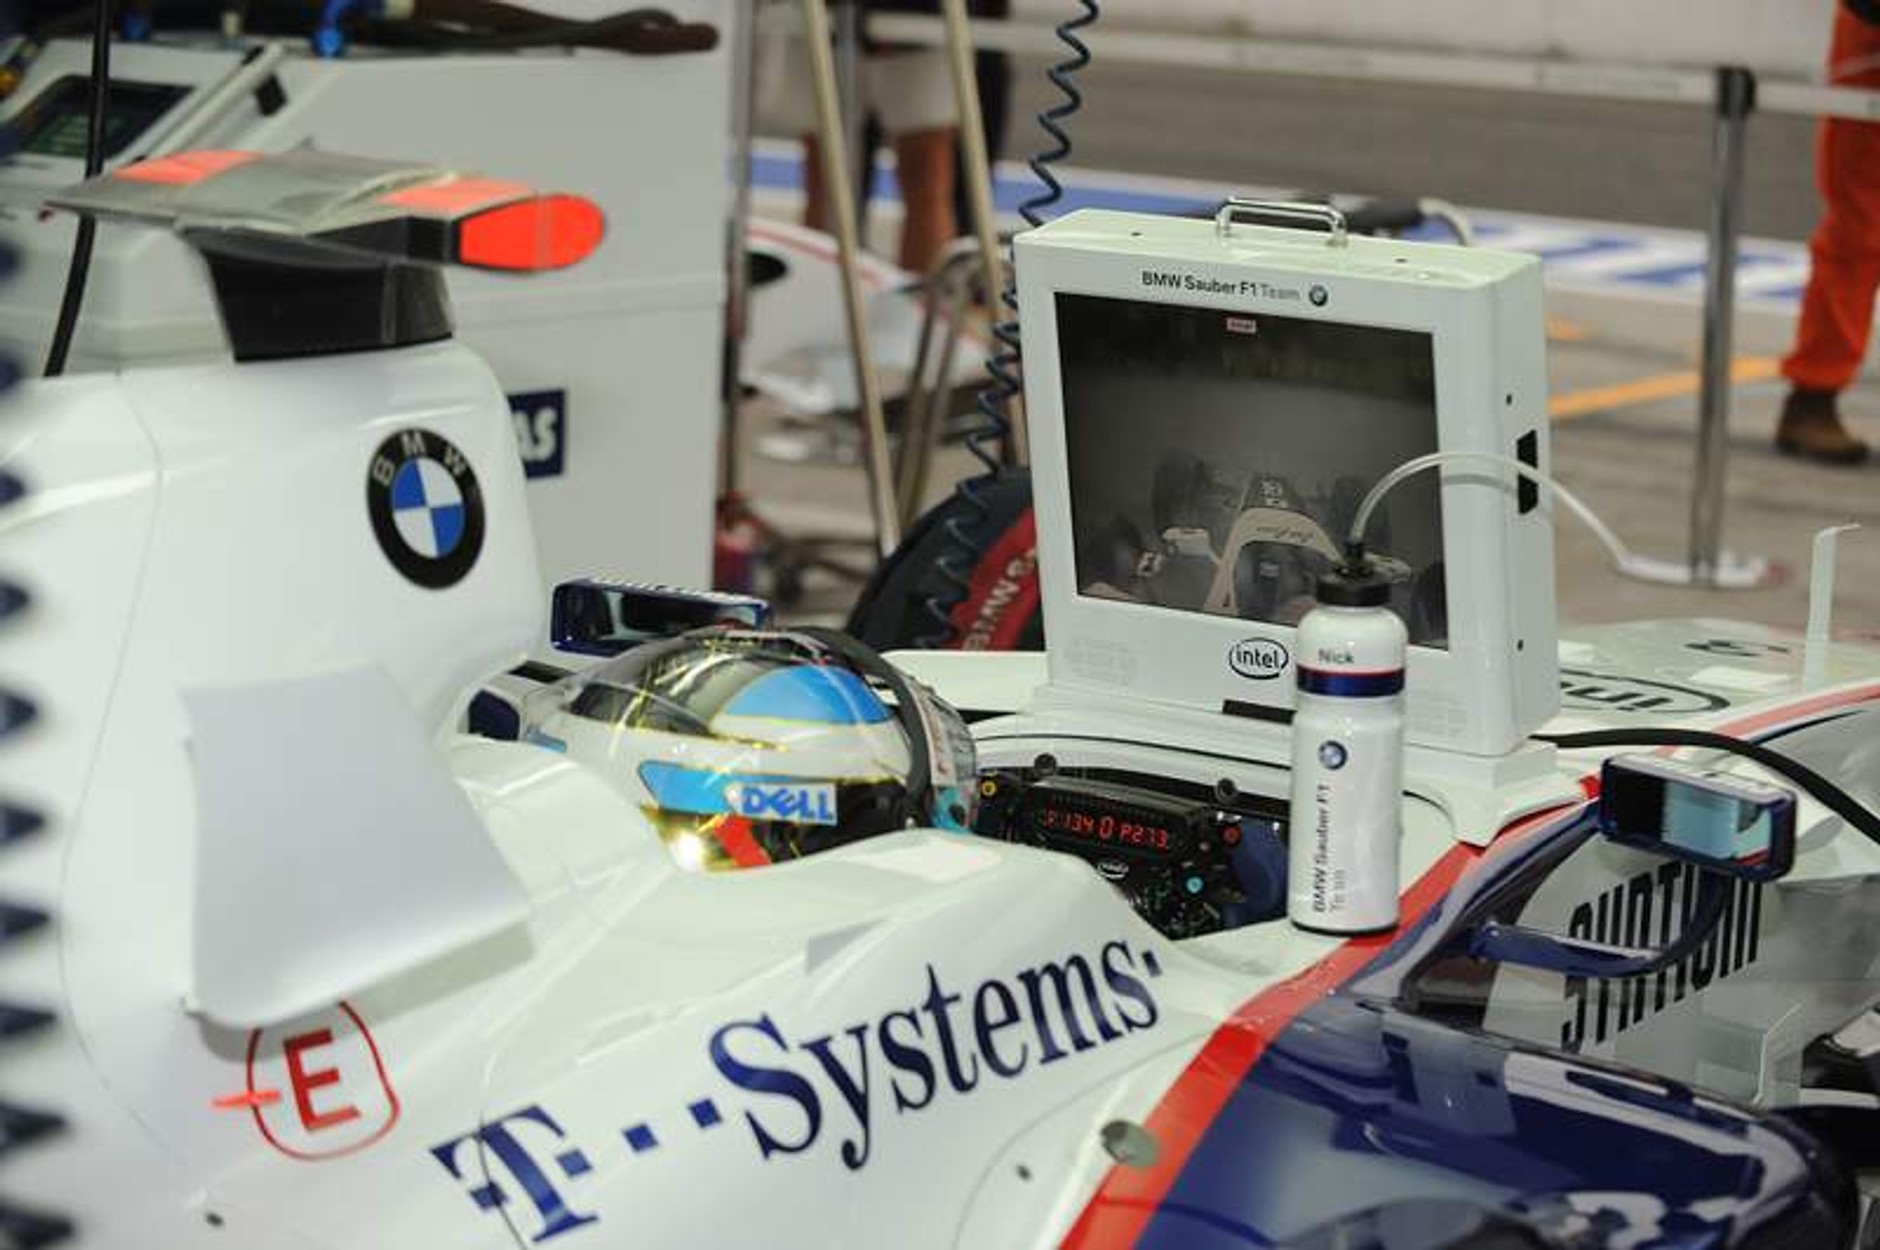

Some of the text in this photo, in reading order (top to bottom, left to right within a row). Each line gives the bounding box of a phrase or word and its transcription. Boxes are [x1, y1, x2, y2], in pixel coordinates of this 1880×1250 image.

[1142, 270, 1300, 300] BMW Sauber F1 Team
[373, 431, 467, 487] BMW
[1236, 644, 1280, 669] intel
[1318, 648, 1355, 664] Nick
[742, 787, 834, 821] DELL
[1313, 867, 1328, 913] BMW
[283, 1028, 362, 1133] E
